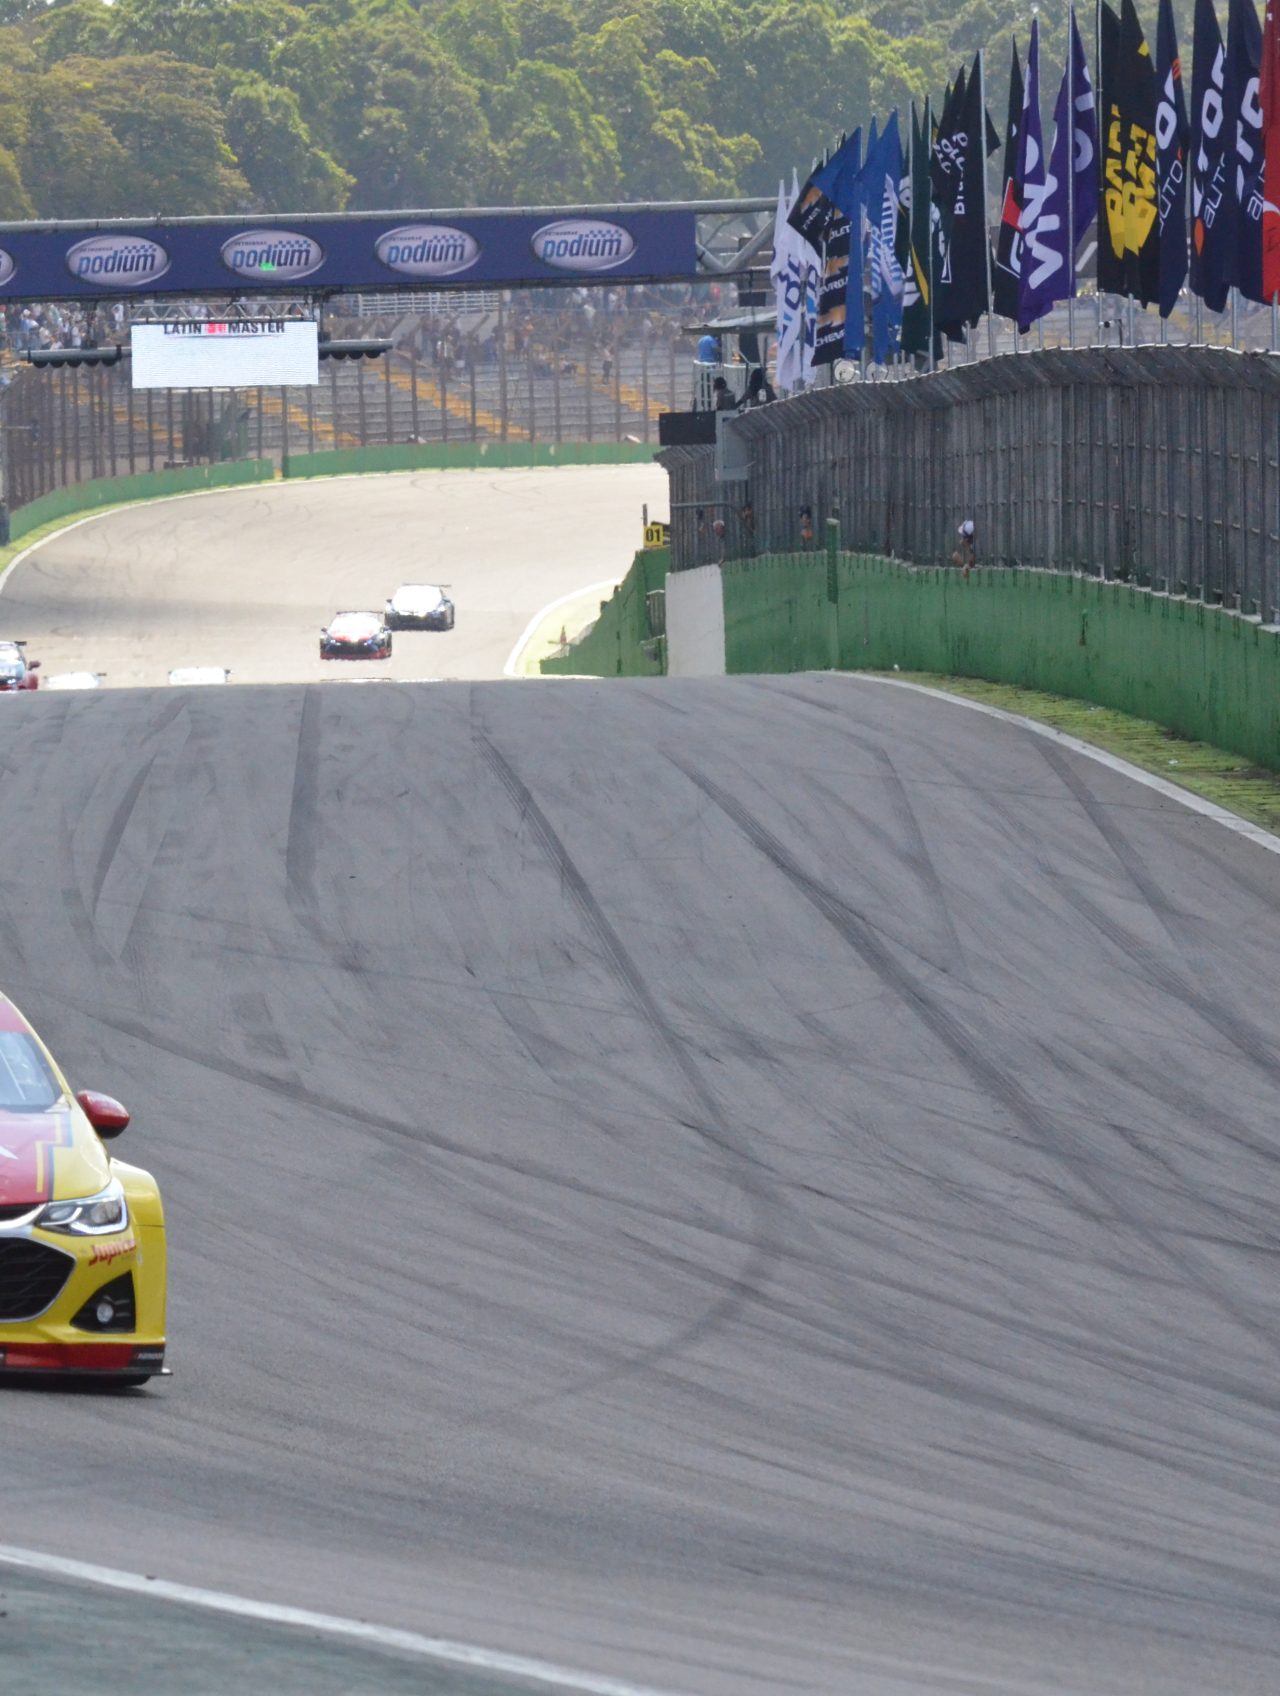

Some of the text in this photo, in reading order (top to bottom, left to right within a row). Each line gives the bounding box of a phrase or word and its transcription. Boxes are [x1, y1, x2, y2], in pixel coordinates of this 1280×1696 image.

[232, 244, 311, 271] podium
[387, 239, 466, 265] podium
[543, 234, 621, 260] podium
[77, 249, 156, 277] podium
[163, 322, 201, 335] LATIN
[228, 321, 285, 334] MASTER
[645, 528, 661, 543] 01
